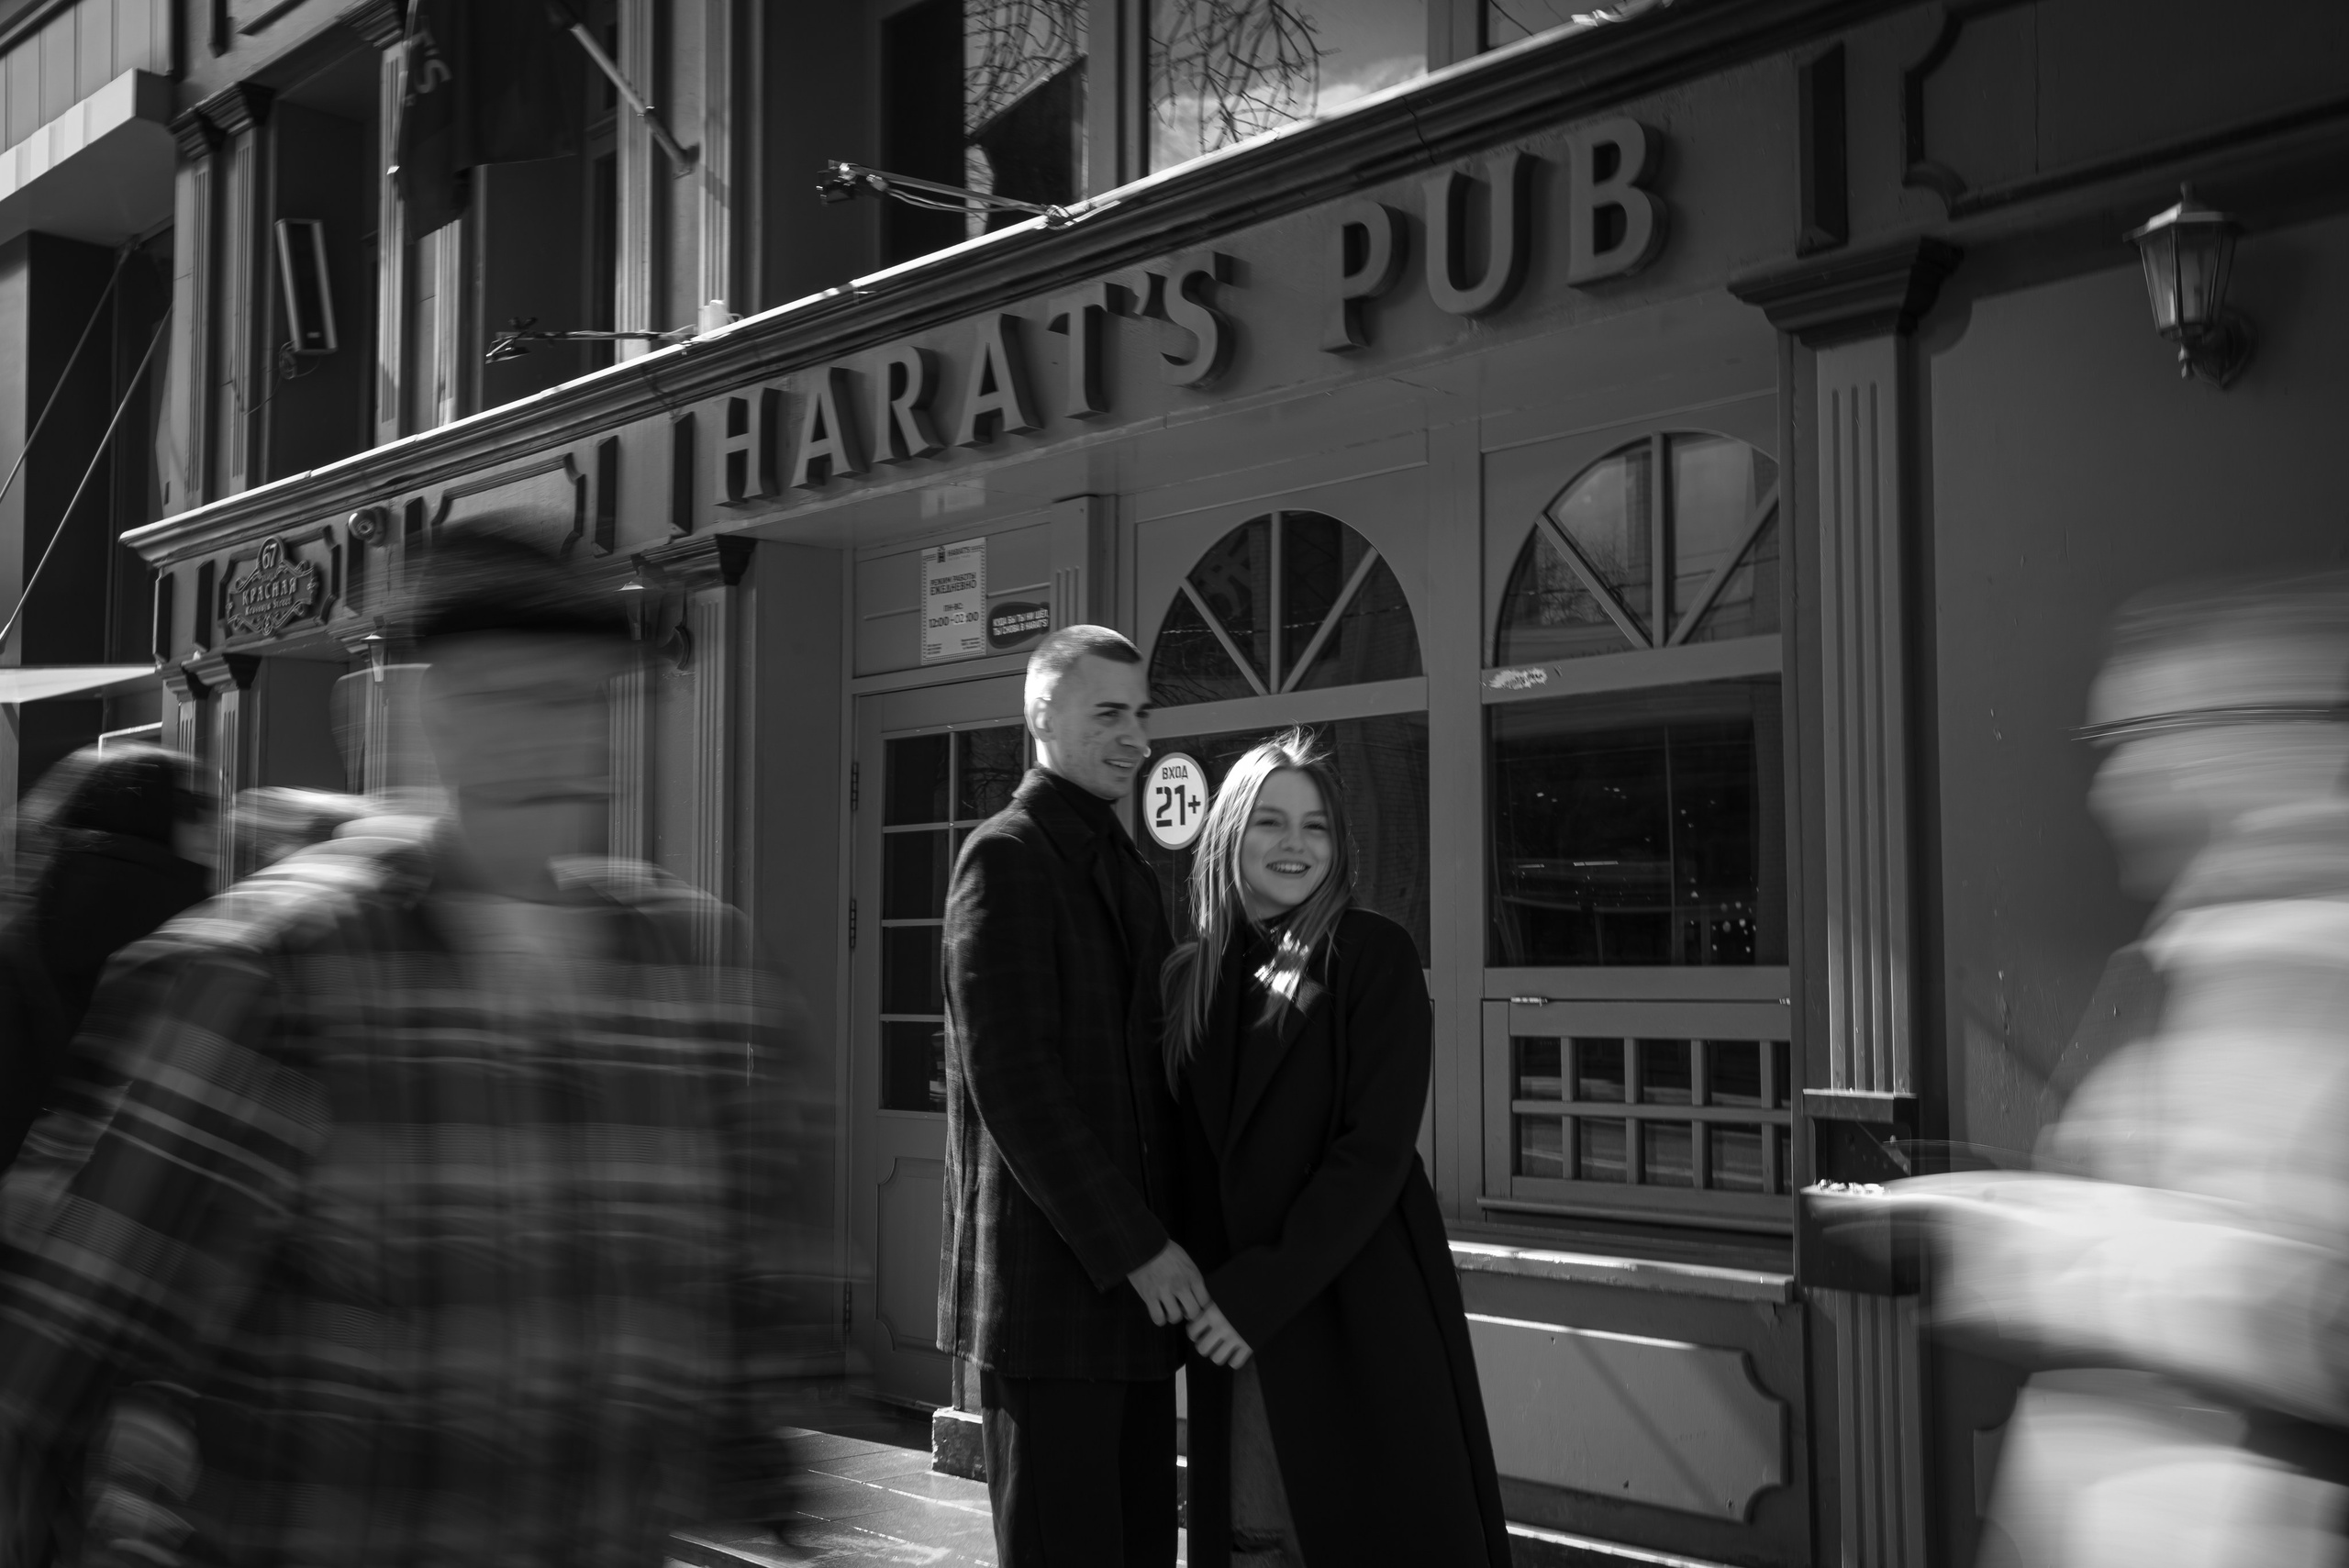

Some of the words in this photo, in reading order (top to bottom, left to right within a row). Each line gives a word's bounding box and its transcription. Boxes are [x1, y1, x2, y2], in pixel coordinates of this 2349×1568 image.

[714, 250, 1246, 507] HARAT'S
[1319, 115, 1668, 354] PUB
[262, 543, 277, 569] 67
[952, 572, 976, 582] РАБОТЫ
[242, 577, 296, 606] КРАСНАЯ
[930, 579, 977, 595] ЕЖЕДНЕВНО
[273, 596, 292, 609] Street
[993, 617, 1007, 627] КУДА
[1008, 616, 1017, 624] БЫ
[1017, 614, 1027, 622] ТЫ
[1027, 612, 1034, 621] НИ
[993, 627, 1002, 636] ТЫ
[1002, 624, 1020, 635] СНОВА
[1020, 623, 1026, 631] В
[1162, 765, 1188, 780] ВХОД
[1156, 784, 1201, 828] 21+
